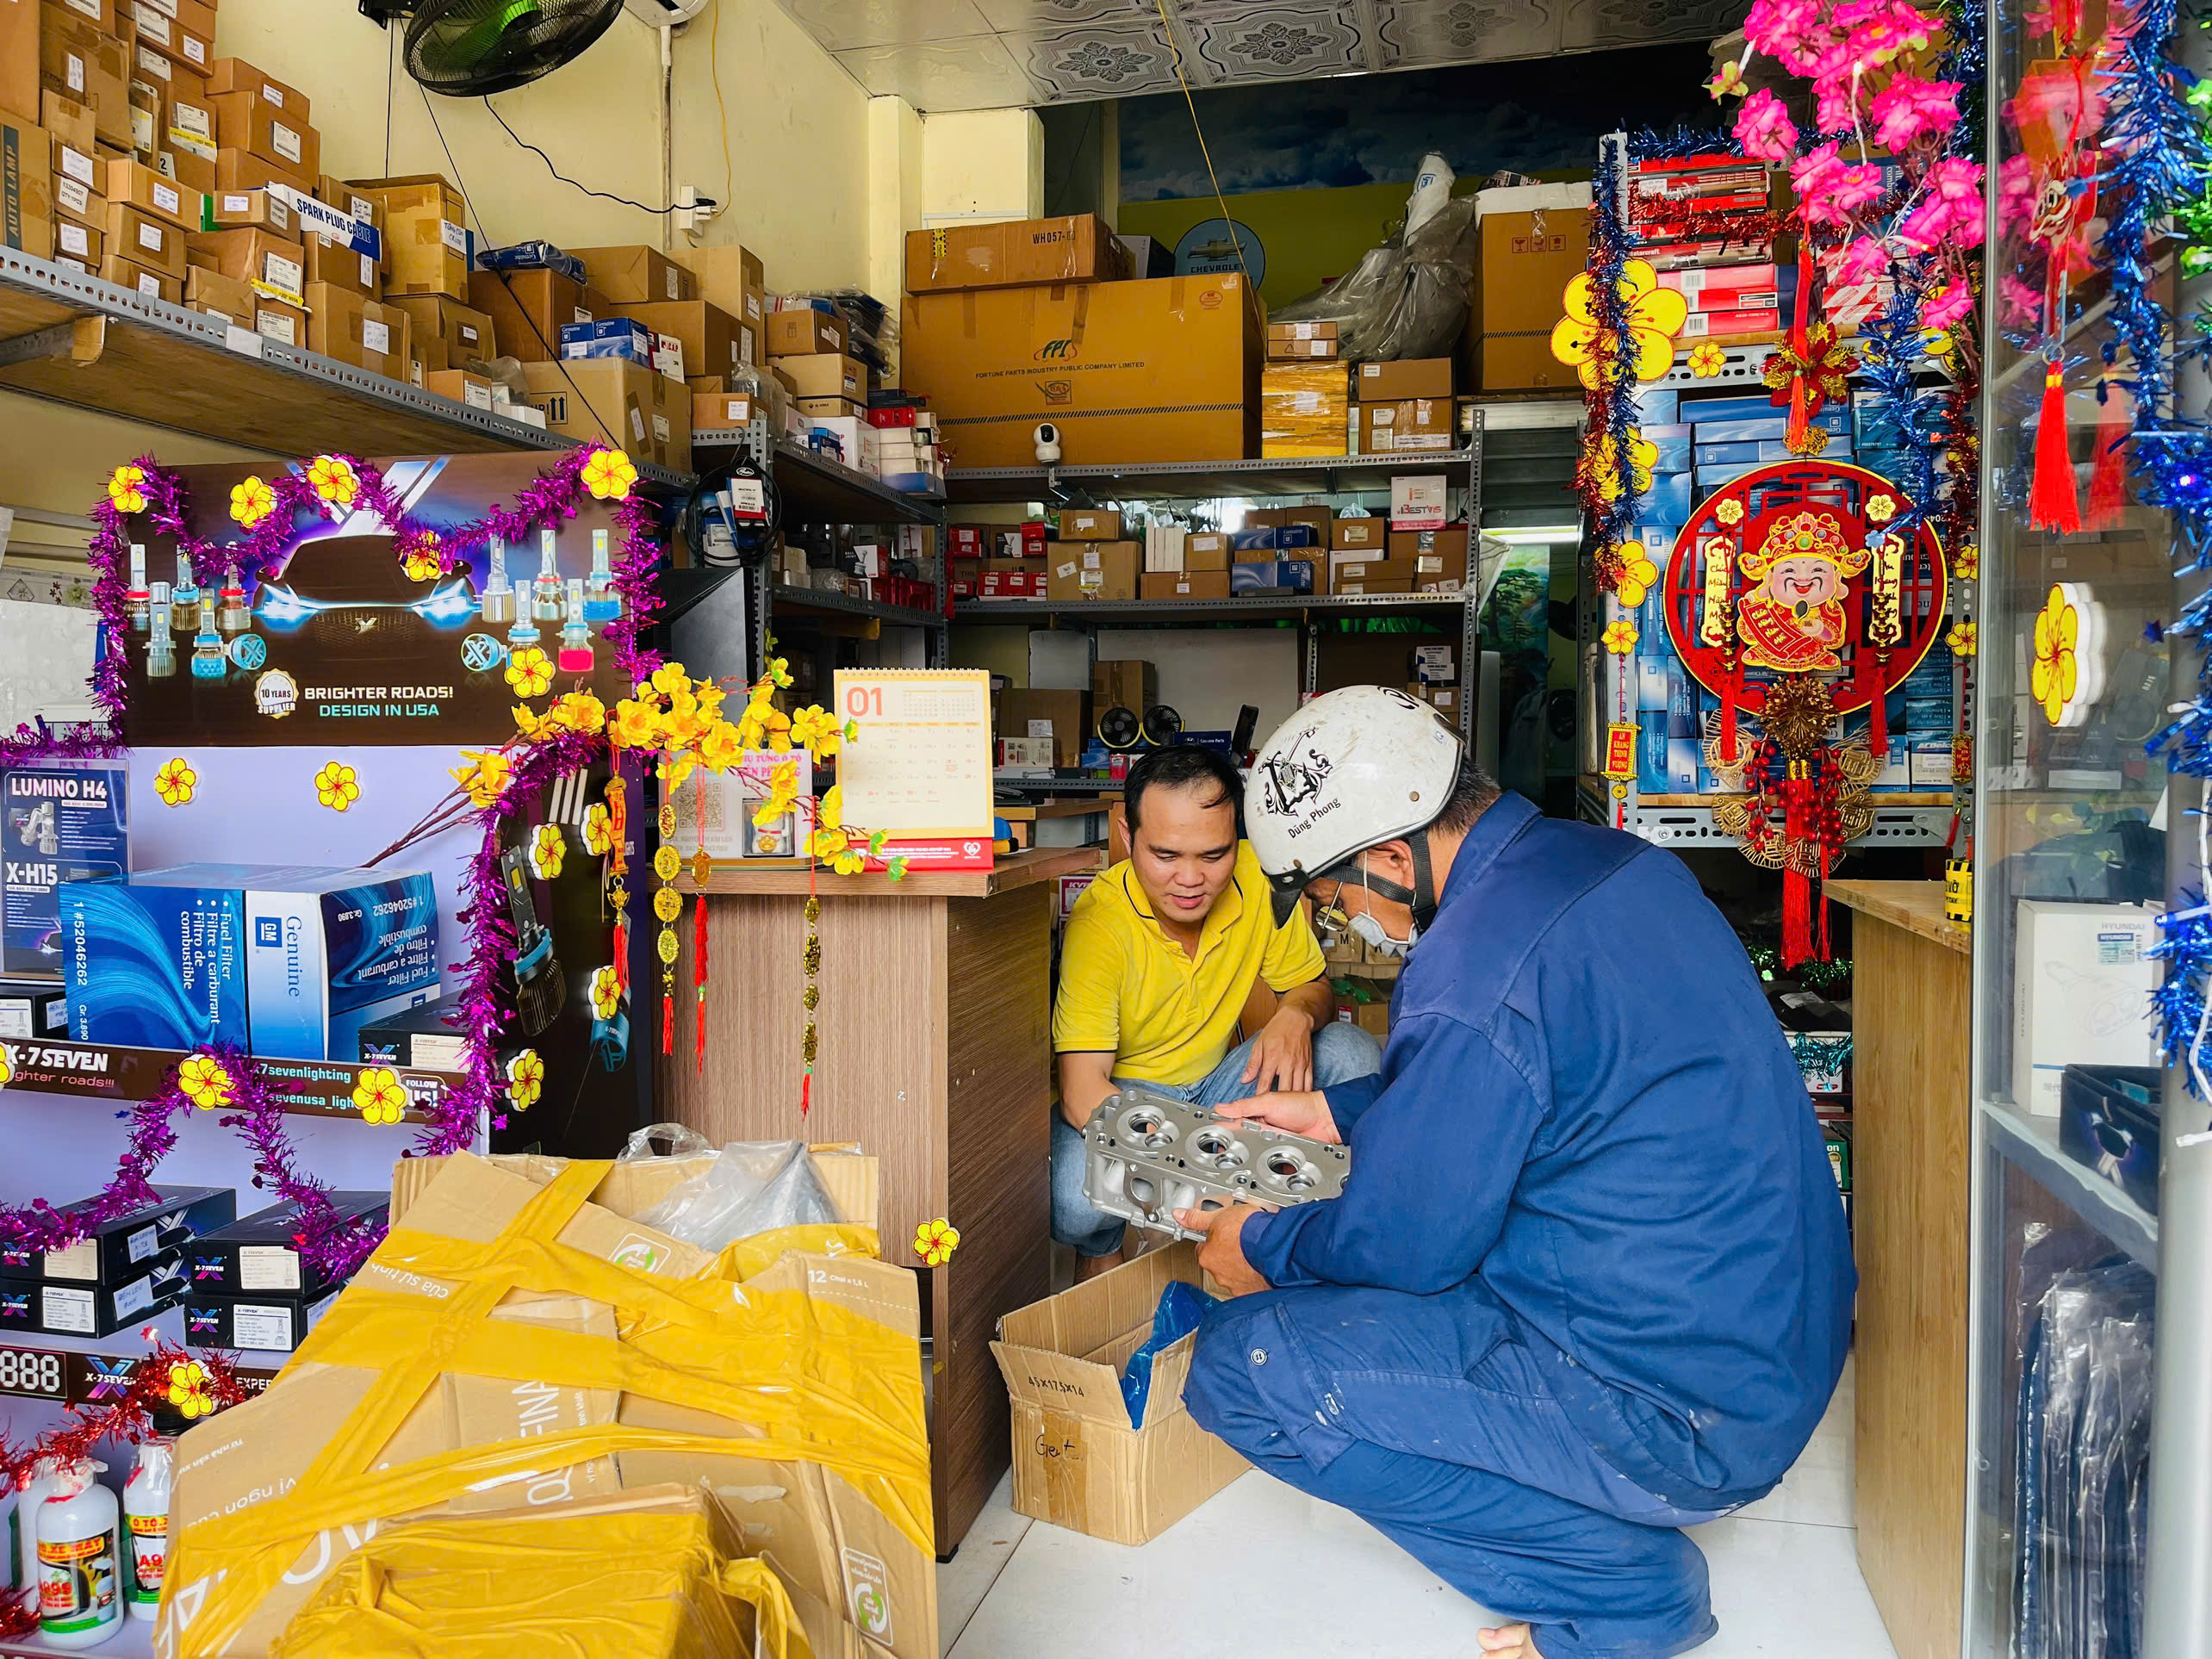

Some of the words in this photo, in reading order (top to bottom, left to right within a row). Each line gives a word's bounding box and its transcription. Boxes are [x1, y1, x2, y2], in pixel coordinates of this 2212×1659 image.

[6, 145, 18, 190] LAMP
[7, 196, 19, 237] AUTO
[297, 198, 325, 222] SPARK
[326, 211, 346, 232] PLUG
[347, 220, 372, 244] CABLE
[1190, 263, 1246, 274] CHEVROLET
[1027, 365, 1058, 375] INDUSTRY
[1118, 361, 1145, 370] LIMITED
[261, 688, 270, 699] 10
[270, 689, 291, 699] YEARS
[304, 687, 388, 699] BRIGHTER
[391, 686, 454, 699] ROADS!
[847, 686, 883, 718] 01
[257, 701, 296, 715] SUPPLIER
[319, 705, 381, 717] DESIGN
[384, 705, 402, 717] IN
[405, 704, 439, 717] USA
[1613, 740, 1629, 749] KHANG
[10, 777, 78, 799] LUMINO
[82, 780, 108, 799] H4
[1287, 819, 1312, 839] Dũng
[1308, 797, 1341, 822] Phong
[5, 861, 59, 886] X-H15
[373, 897, 418, 917] #52046262
[192, 911, 203, 950] Filtro
[207, 912, 218, 947] Filtre
[221, 911, 232, 935] Fuel
[260, 922, 277, 942] GM
[2101, 922, 2147, 932] HYUNDAI
[378, 923, 427, 946] combustible
[1339, 933, 1349, 945] M
[73, 910, 87, 986] #52046262
[180, 910, 194, 991] combustible
[393, 942, 404, 956] de
[405, 937, 428, 953] Filtro
[194, 953, 204, 968] de
[221, 937, 233, 980] Filter
[285, 916, 301, 997] Genuine
[407, 952, 429, 966] Filtre
[357, 959, 399, 980] carburant
[388, 970, 410, 986] Filter
[410, 966, 429, 982] Fuel
[208, 958, 221, 1025] carburant
[363, 1053, 397, 1061] X-7SEVEN
[60, 1075, 115, 1089] roads!!!
[405, 1078, 438, 1090] FOLLOW
[807, 1269, 828, 1283] 12
[2, 1301, 28, 1309] X-7SEVEN
[278, 1476, 297, 1495] vị
[225, 1485, 273, 1514] ngon
